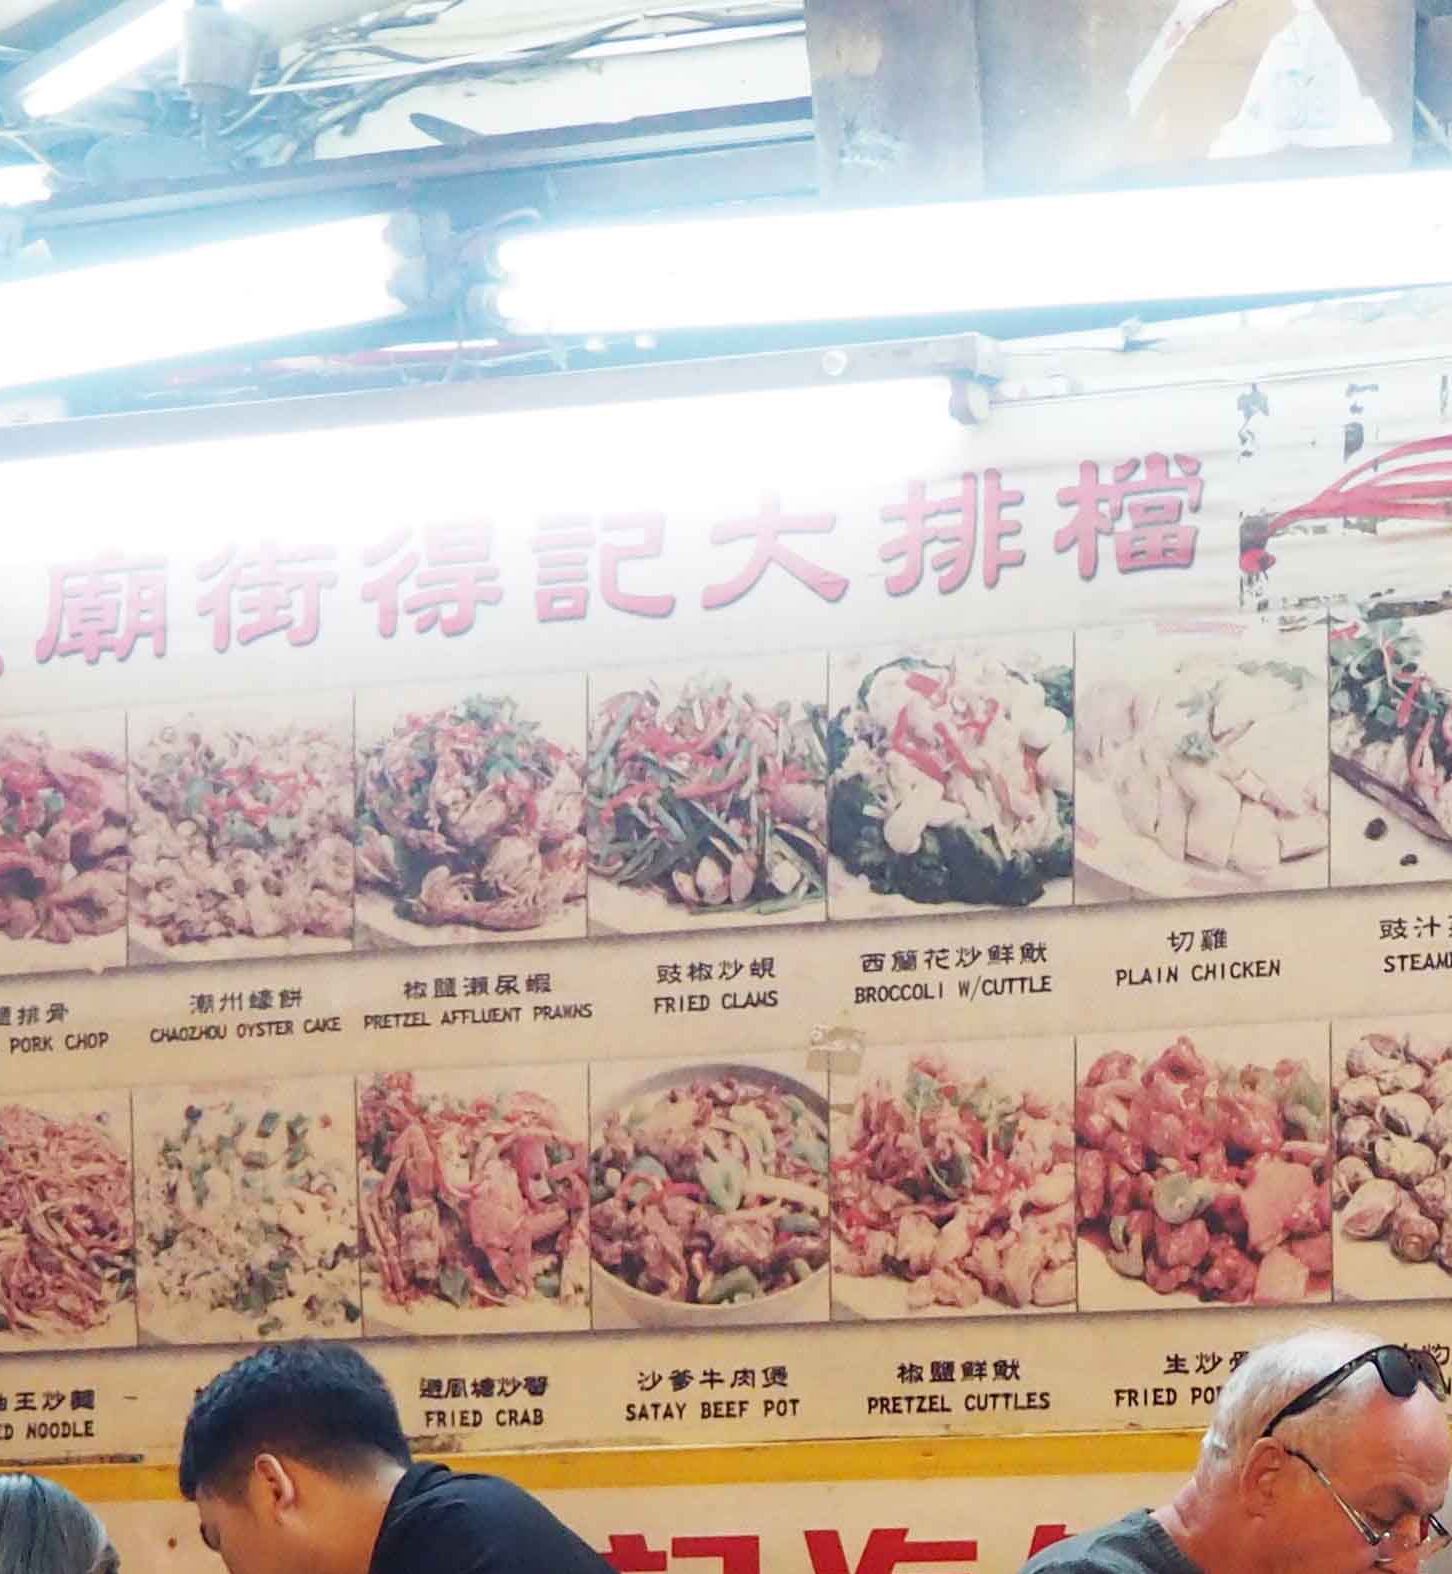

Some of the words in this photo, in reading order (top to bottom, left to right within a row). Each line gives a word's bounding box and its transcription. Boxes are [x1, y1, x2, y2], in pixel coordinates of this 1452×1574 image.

[35, 451, 1205, 666] 廟街得記大排檔
[1115, 964, 1179, 987] PLAIN
[1191, 959, 1282, 983] CHICKEN
[653, 993, 711, 1014] FRIED
[721, 989, 779, 1010] CLAMS
[853, 980, 944, 1004] BROCCOLI
[957, 974, 1053, 1002] W/CUTTLE
[363, 1010, 432, 1031] PRETZEL
[440, 1006, 523, 1026] AFFLUENT
[532, 1002, 594, 1022] PRAWNS
[9, 1035, 54, 1055] PORK
[64, 1031, 110, 1051] CHOP
[149, 1023, 228, 1044] CHAOZHOU
[236, 1019, 295, 1039] OYSTER
[303, 1016, 343, 1034] CAKE
[625, 1401, 687, 1423] SATAY
[700, 1399, 750, 1420] BEEF
[763, 1397, 801, 1418] POT
[866, 1393, 952, 1416] PRETZEL
[964, 1390, 1052, 1413] CUTTLES
[1113, 1386, 1179, 1409] FRIED
[25, 1419, 96, 1440] NOODLE
[425, 1409, 484, 1429] FRIED
[495, 1407, 545, 1428] CRAB
